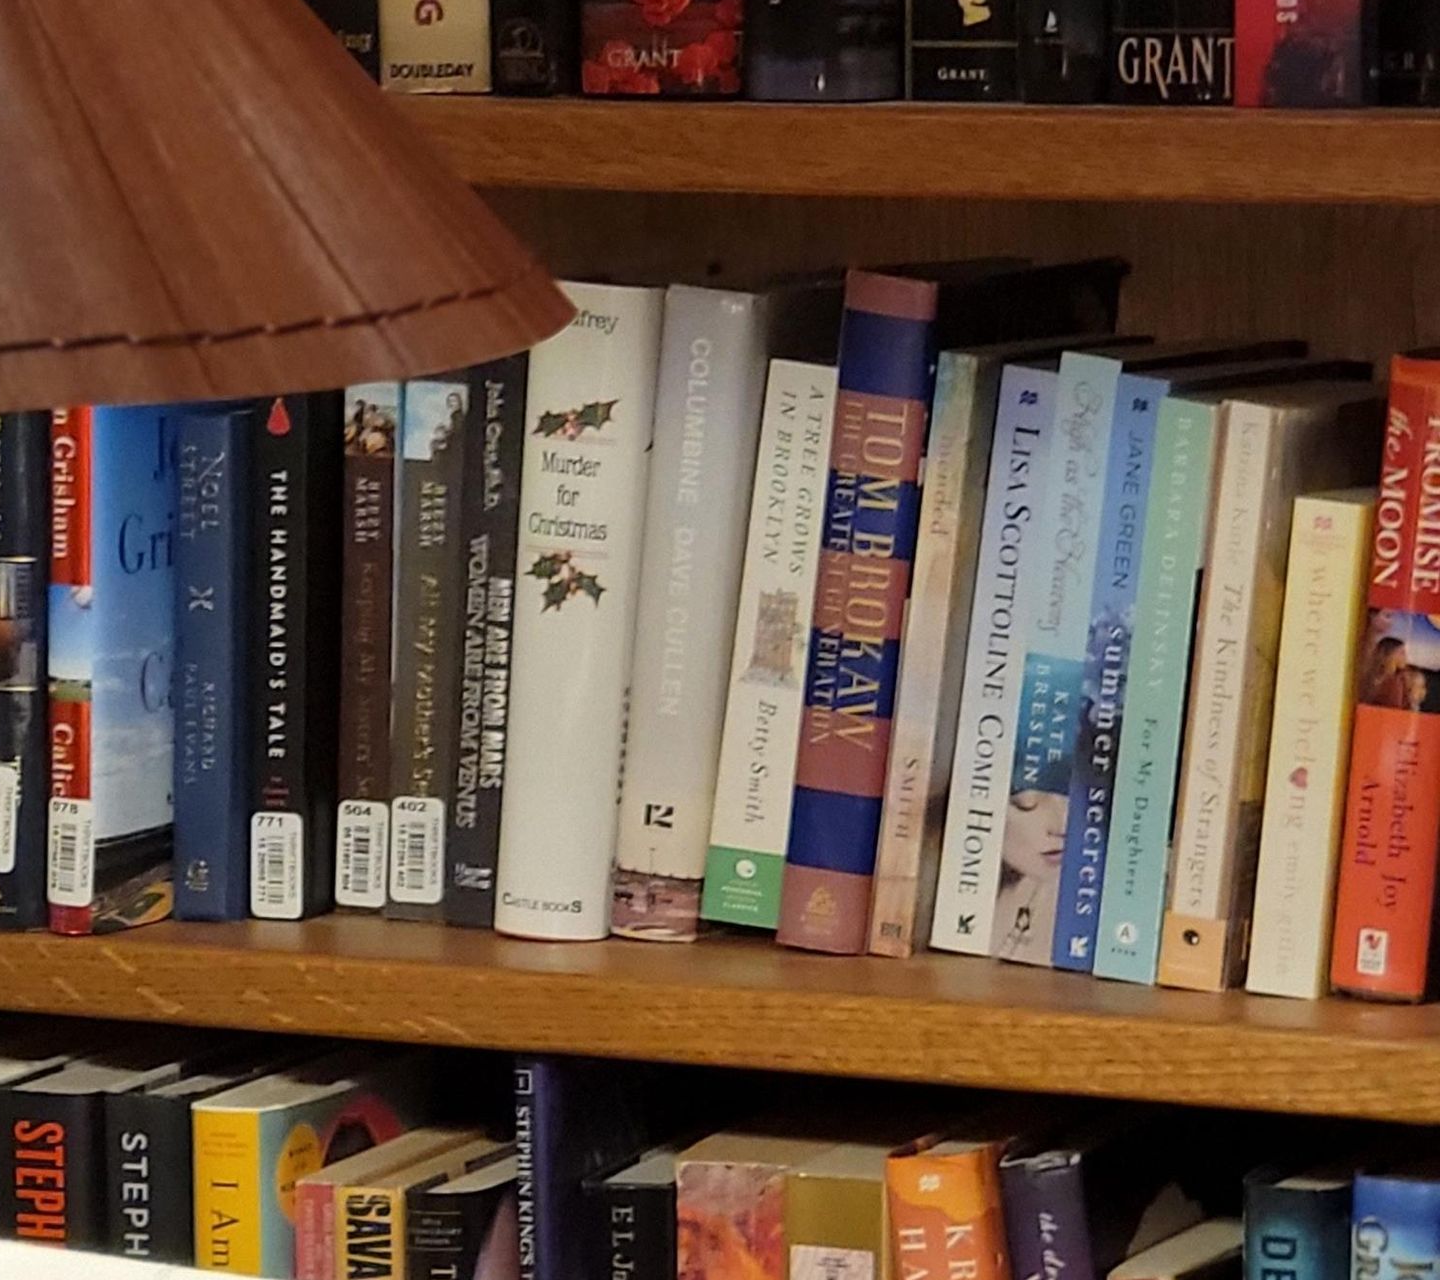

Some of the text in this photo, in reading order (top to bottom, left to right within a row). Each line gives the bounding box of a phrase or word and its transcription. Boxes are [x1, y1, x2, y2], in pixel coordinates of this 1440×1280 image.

[389, 62, 476, 79] DOUBLEDAY
[606, 47, 682, 69] GRANT
[1116, 34, 1236, 101] GRANT
[540, 450, 602, 478] Murder
[674, 339, 712, 503] COLUMBINE
[762, 389, 797, 564] IN BROOKLYN
[1163, 416, 1192, 540] BARBARA
[52, 436, 77, 559] Grisham
[180, 443, 196, 541] STREET
[527, 511, 608, 542] Christmas
[555, 485, 581, 507] for
[788, 412, 824, 577] TREE GROWS
[1109, 429, 1145, 590] JANE GREEN
[1371, 407, 1410, 589] the MOON
[266, 469, 291, 758] THE HANDMAID'S TALE
[486, 577, 511, 621] MEN
[824, 403, 909, 751] TOM BROKAW
[181, 652, 199, 786] PAUL EVANS
[456, 535, 490, 829] WOMEN ARE FROM VENUS
[957, 424, 1041, 895] LISA SCOTTOLINE COME HOME
[198, 680, 217, 772] RICHARD
[1021, 661, 1050, 786] BRESLIN
[1047, 690, 1071, 766] KATE
[1074, 623, 1125, 917] summer secrets
[1185, 637, 1238, 909] Kindness of Strangers
[256, 816, 284, 828] 771
[343, 805, 373, 817] 504
[397, 800, 428, 813] 402
[742, 761, 770, 824] Smith
[1123, 716, 1159, 898] For My Daughters
[1354, 772, 1379, 867] Arnold
[1387, 737, 1421, 859] Elizabeth
[11, 1119, 68, 1243] STEPH
[121, 1132, 151, 1258] STEPH
[514, 1105, 534, 1197] STEPHEN
